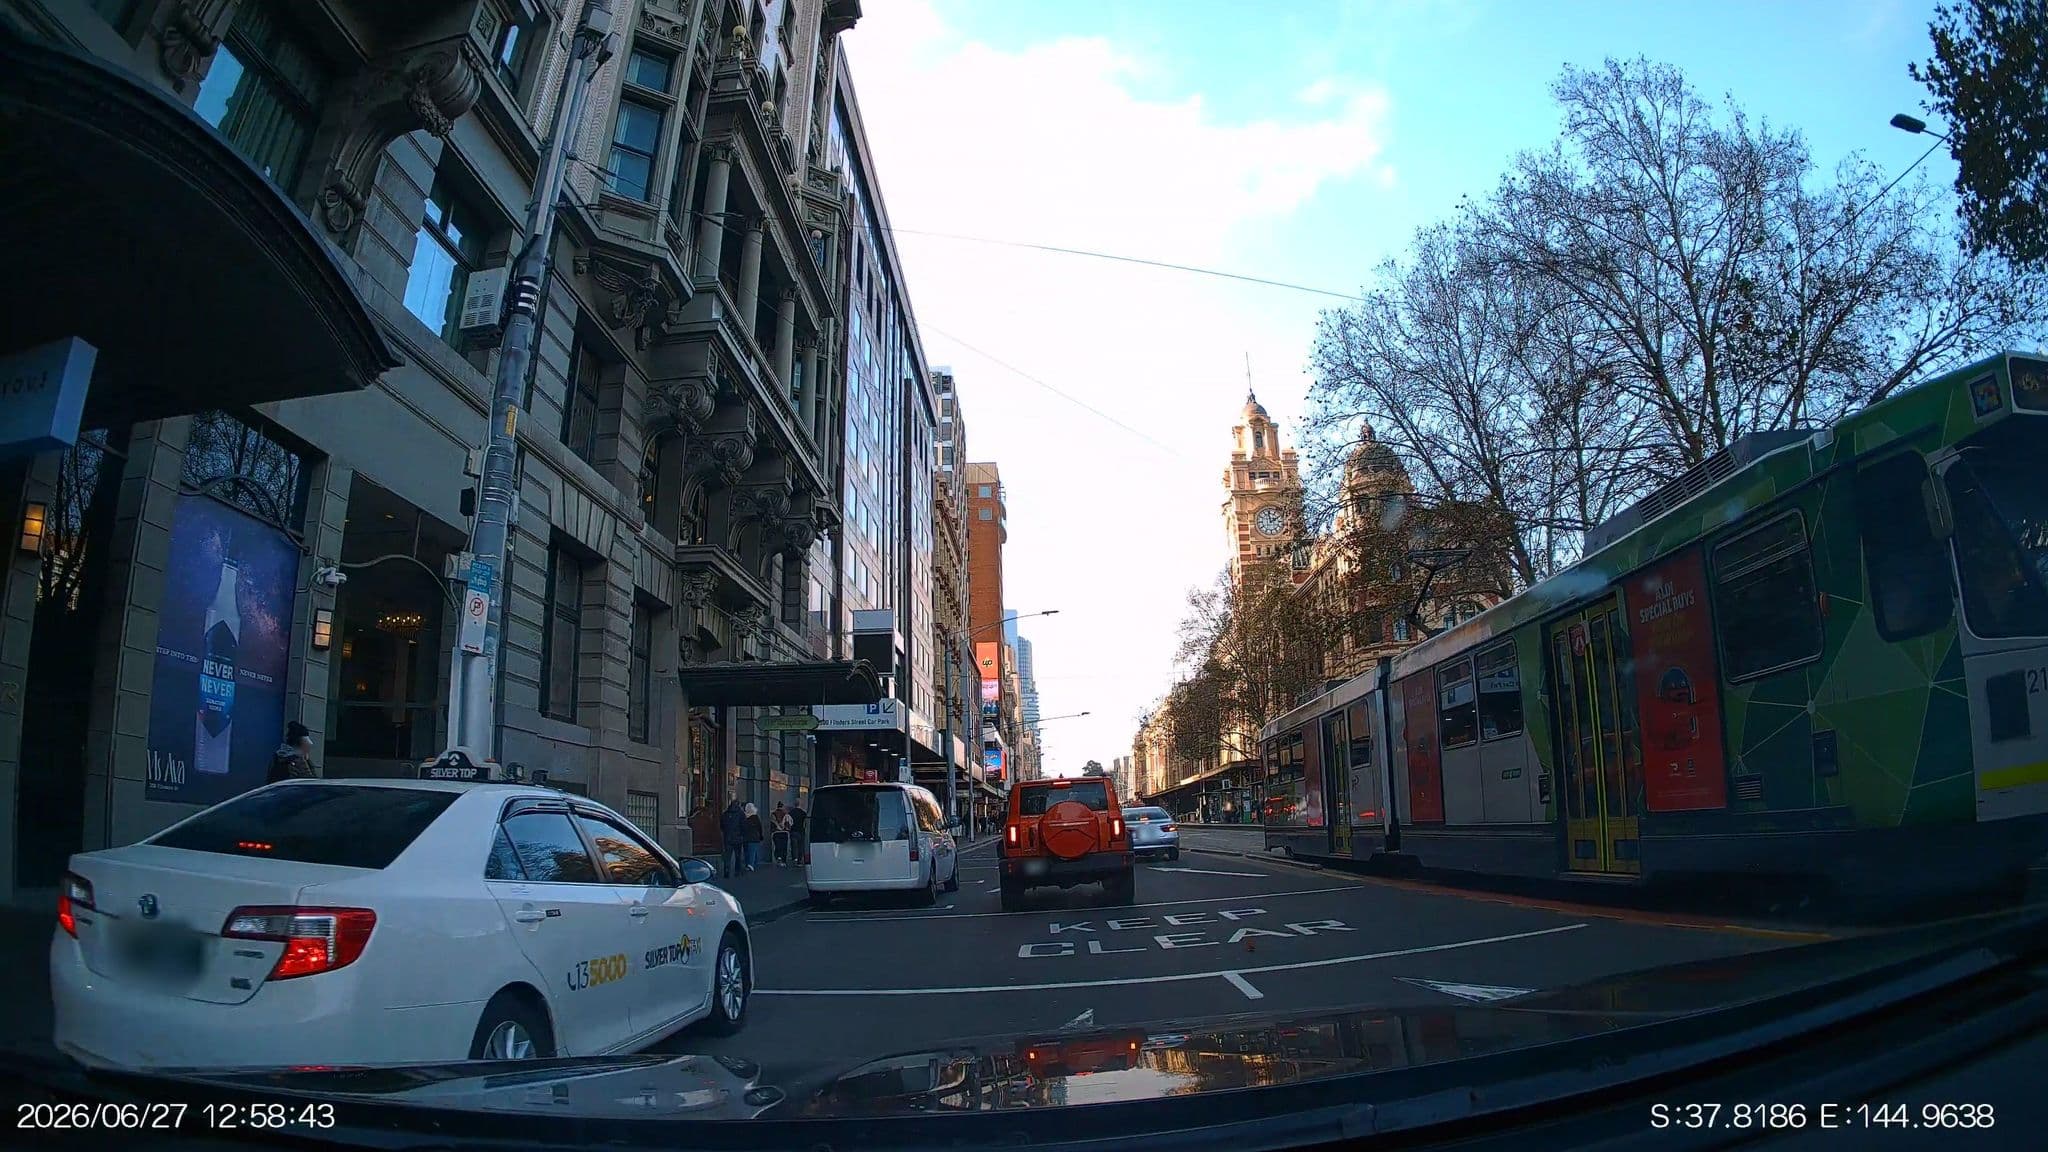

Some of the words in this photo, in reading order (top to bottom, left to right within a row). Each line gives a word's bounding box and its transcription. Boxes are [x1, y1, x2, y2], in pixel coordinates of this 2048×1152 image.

[1655, 581, 1674, 600] ALDI
[1640, 597, 1673, 624] SPECIAL
[1672, 589, 1696, 611] BUYS
[202, 659, 234, 680] NEVER
[201, 677, 232, 697] NEVER
[430, 767, 459, 778] SILVER
[459, 768, 478, 778] TOP
[1049, 908, 1268, 934] KEEP
[1018, 919, 1359, 958] CLEAR
[644, 948, 669, 970] SILVER
[667, 943, 681, 964] TOP
